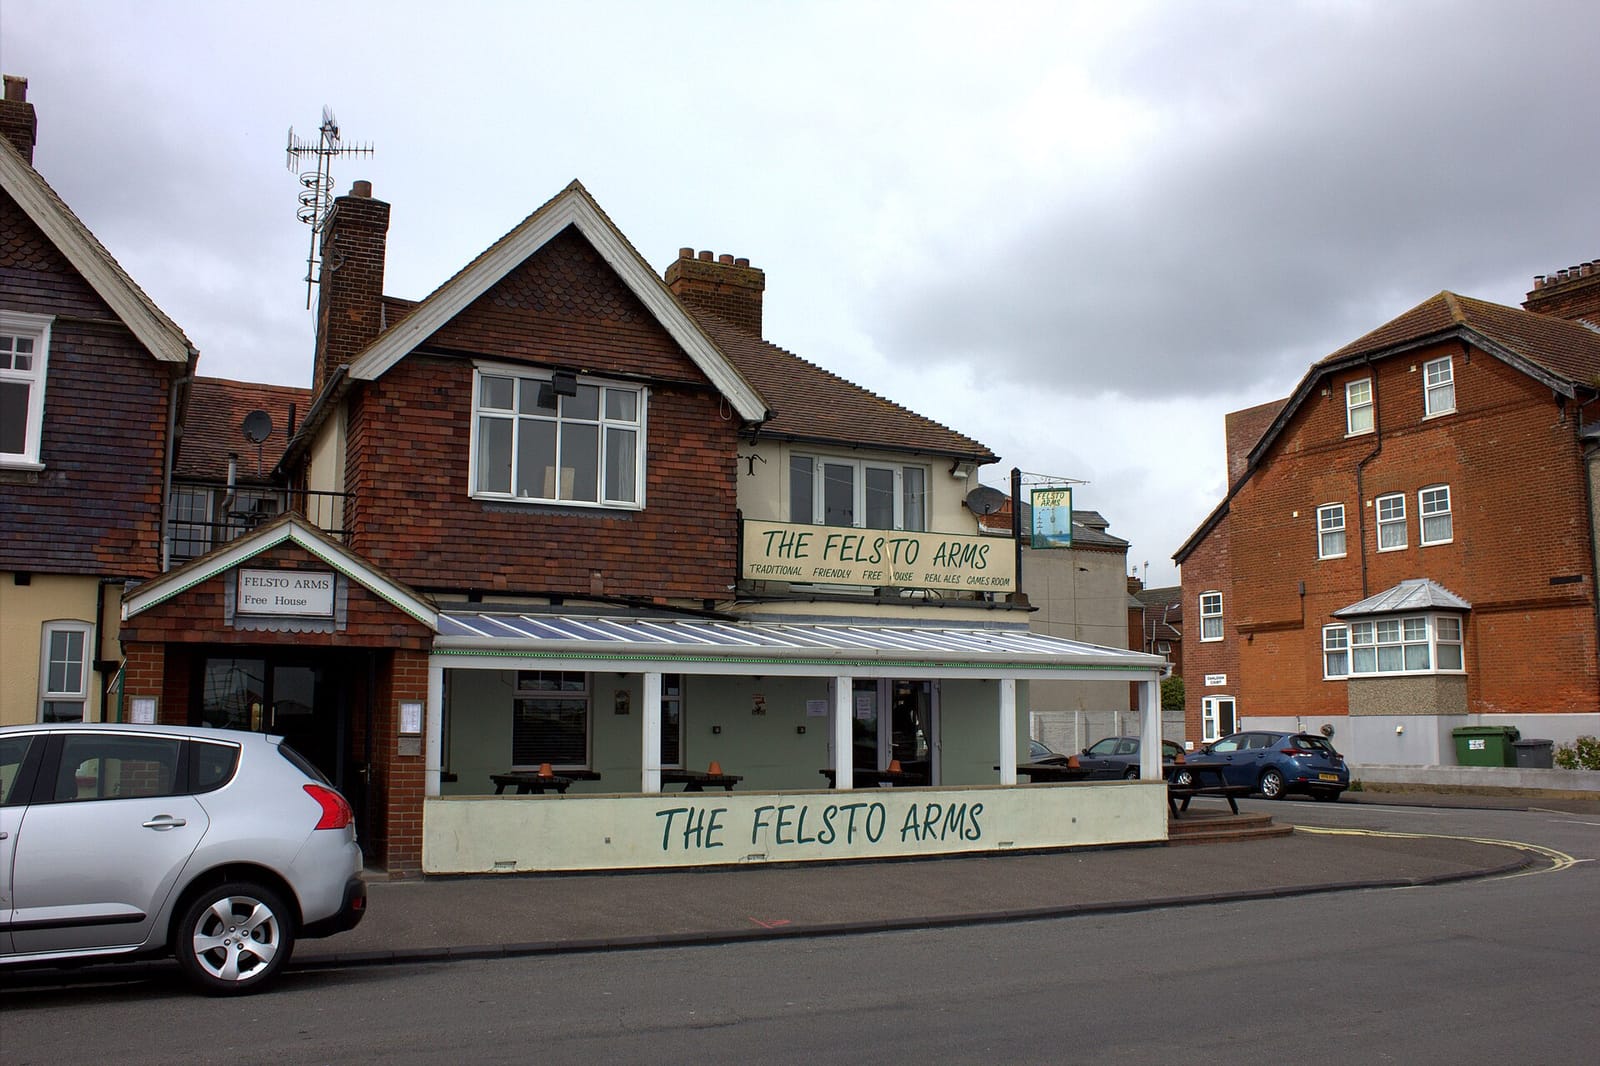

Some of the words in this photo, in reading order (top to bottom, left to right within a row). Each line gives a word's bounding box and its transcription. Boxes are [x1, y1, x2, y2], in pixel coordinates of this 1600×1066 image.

[1037, 492, 1065, 500] FELSTO
[1040, 499, 1061, 507] ARMS
[763, 530, 814, 559] THE
[823, 534, 920, 565] FELSTO
[933, 541, 990, 570] ARMS
[749, 564, 803, 576] TRADITIONAL
[812, 567, 852, 579] FRIENDLY
[862, 570, 883, 581] FREE
[924, 573, 942, 583] REAL
[943, 574, 961, 584] ALES
[990, 577, 1011, 587] ROOM
[244, 577, 289, 588] FELSTO
[294, 579, 329, 590] ARMS
[244, 595, 268, 605] Free
[275, 596, 307, 606] House
[655, 807, 727, 850] THE
[751, 802, 886, 845] FELSTO
[900, 802, 984, 842] ARMS
